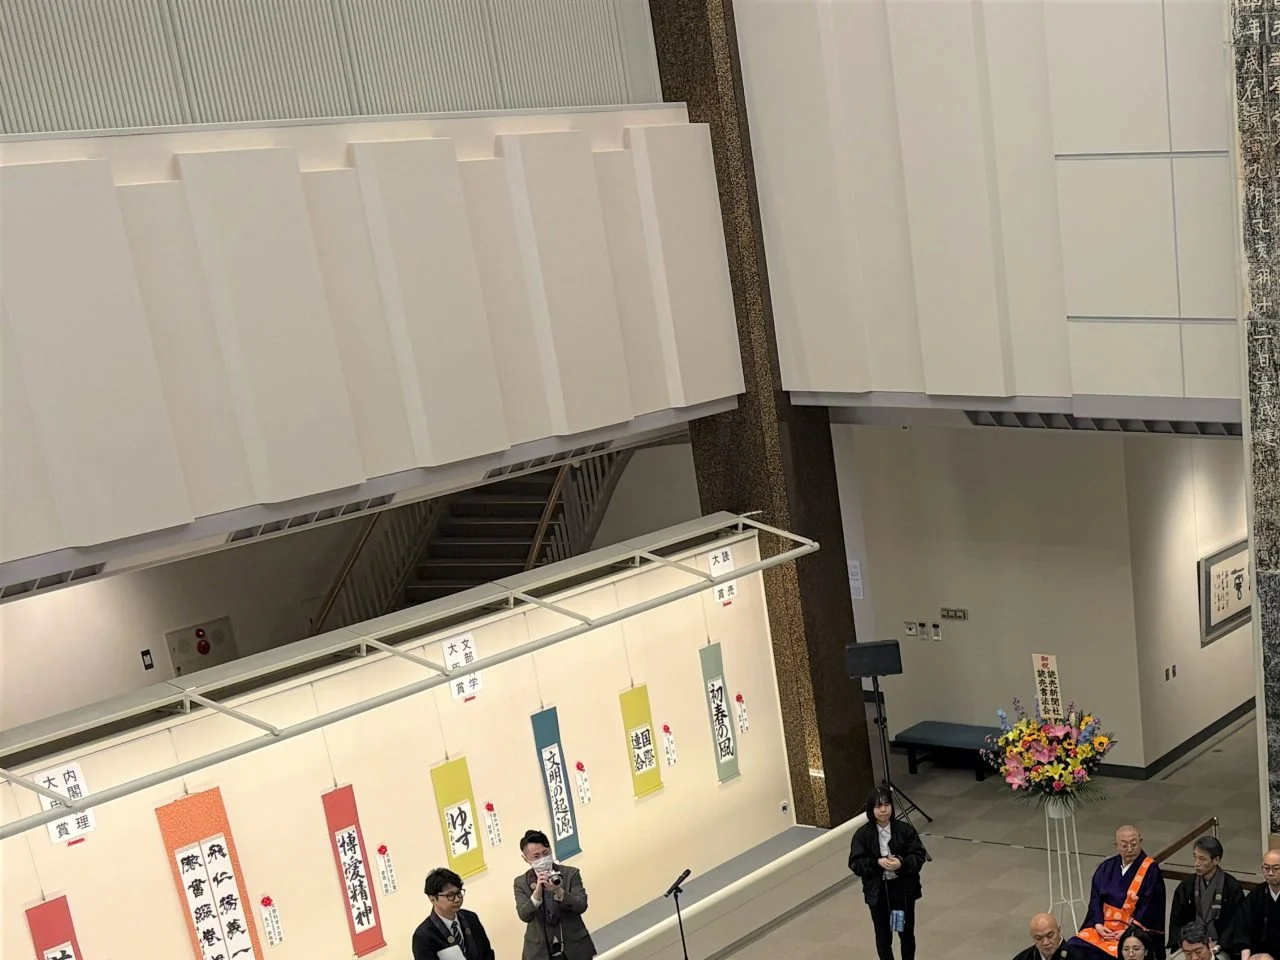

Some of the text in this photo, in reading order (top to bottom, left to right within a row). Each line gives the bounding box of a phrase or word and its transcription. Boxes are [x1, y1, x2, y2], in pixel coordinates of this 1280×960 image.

[709, 683, 734, 760] 初春の風
[63, 769, 91, 830] 内閣理
[449, 806, 473, 851] ゆず
[547, 750, 573, 836] 文明の起源
[338, 829, 374, 927] 博愛精神
